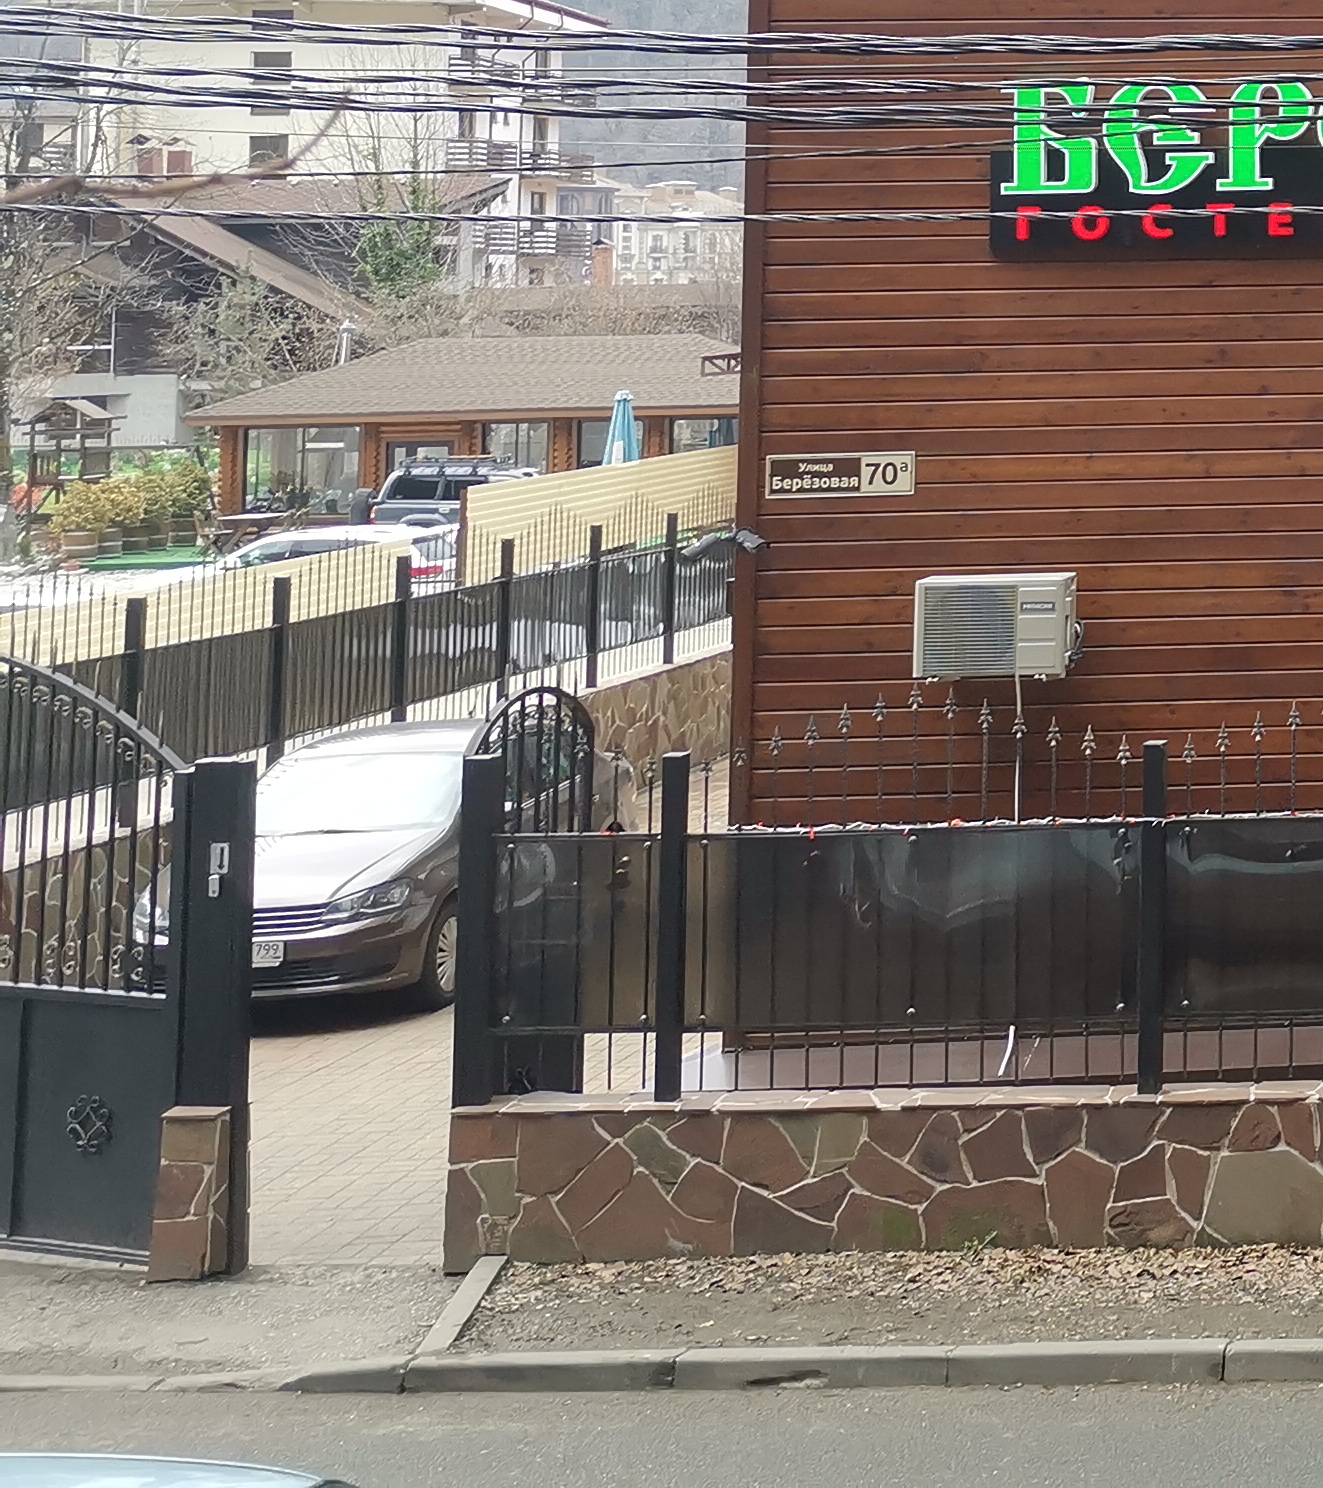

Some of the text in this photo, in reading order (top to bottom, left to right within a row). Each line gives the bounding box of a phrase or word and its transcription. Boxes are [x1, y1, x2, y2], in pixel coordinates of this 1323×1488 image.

[797, 462, 834, 473] Улица
[771, 474, 859, 491] Берёзовая
[255, 943, 280, 957] 799
